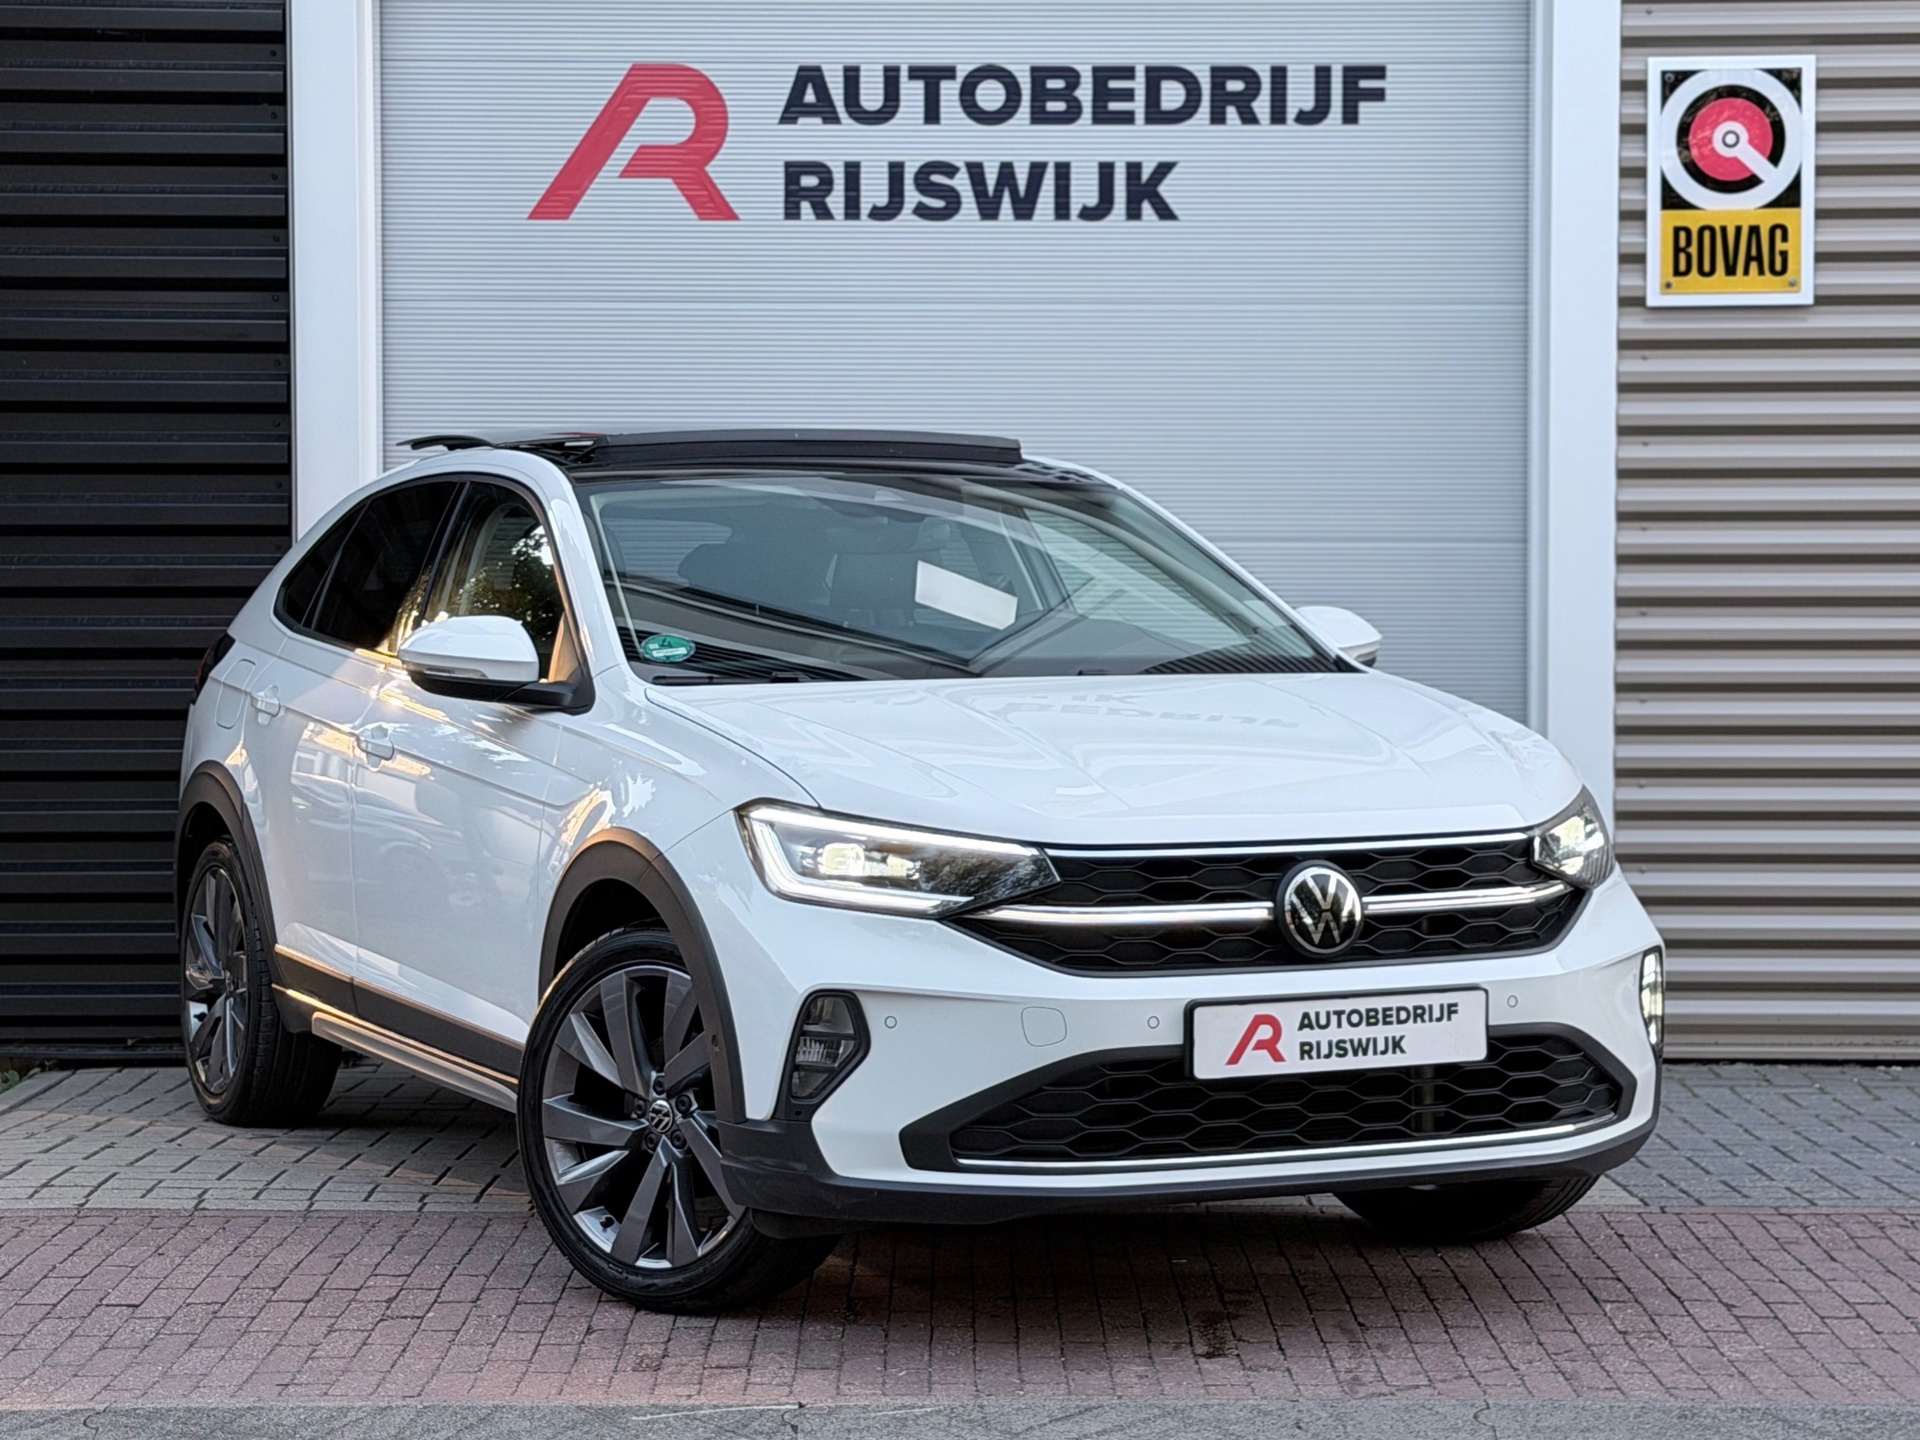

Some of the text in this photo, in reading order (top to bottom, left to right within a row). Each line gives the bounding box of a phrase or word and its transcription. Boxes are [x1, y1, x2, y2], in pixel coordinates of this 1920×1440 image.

[778, 64, 1388, 126] AUTOBEDRIJF
[782, 160, 1179, 221] RIJSWIJK
[1672, 224, 1789, 278] BOVAG
[1297, 1003, 1459, 1031] AUTOBEDRIJF
[1299, 1035, 1407, 1060] RIJSWIJK
